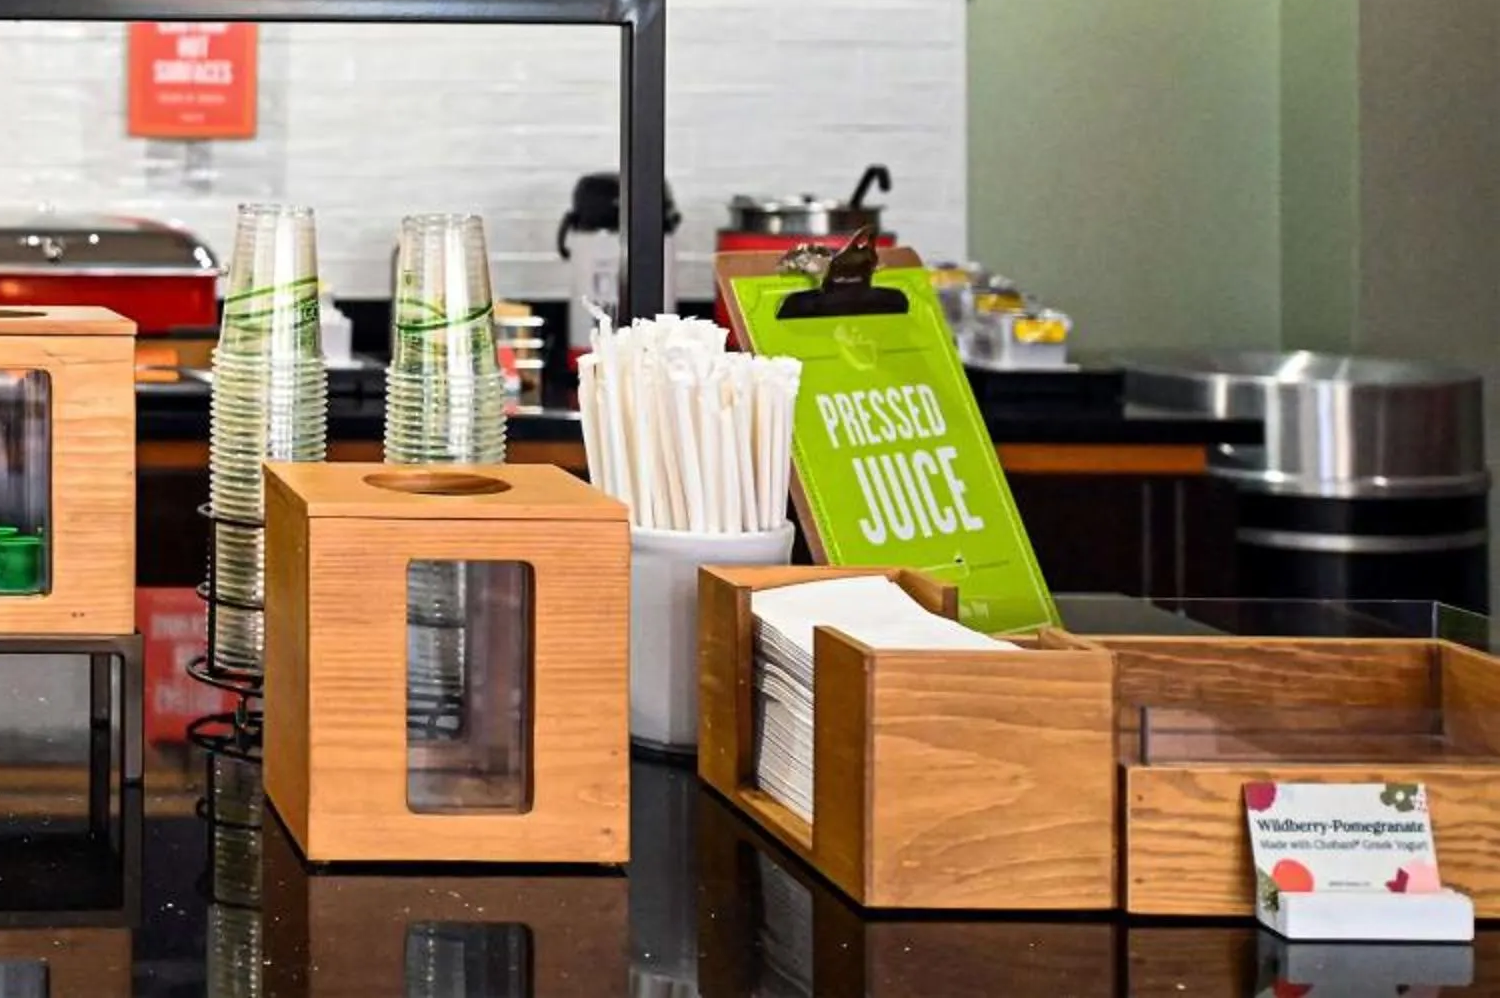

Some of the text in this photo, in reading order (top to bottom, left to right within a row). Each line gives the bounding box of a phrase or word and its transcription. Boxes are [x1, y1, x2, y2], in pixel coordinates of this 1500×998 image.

[815, 383, 948, 449] PRESSED
[852, 445, 985, 546] JUICE
[1255, 818, 1426, 835] Wildberry-Pomegranate
[1260, 840, 1288, 850] Made
[1290, 840, 1311, 850] with
[1362, 840, 1393, 851] Greek
